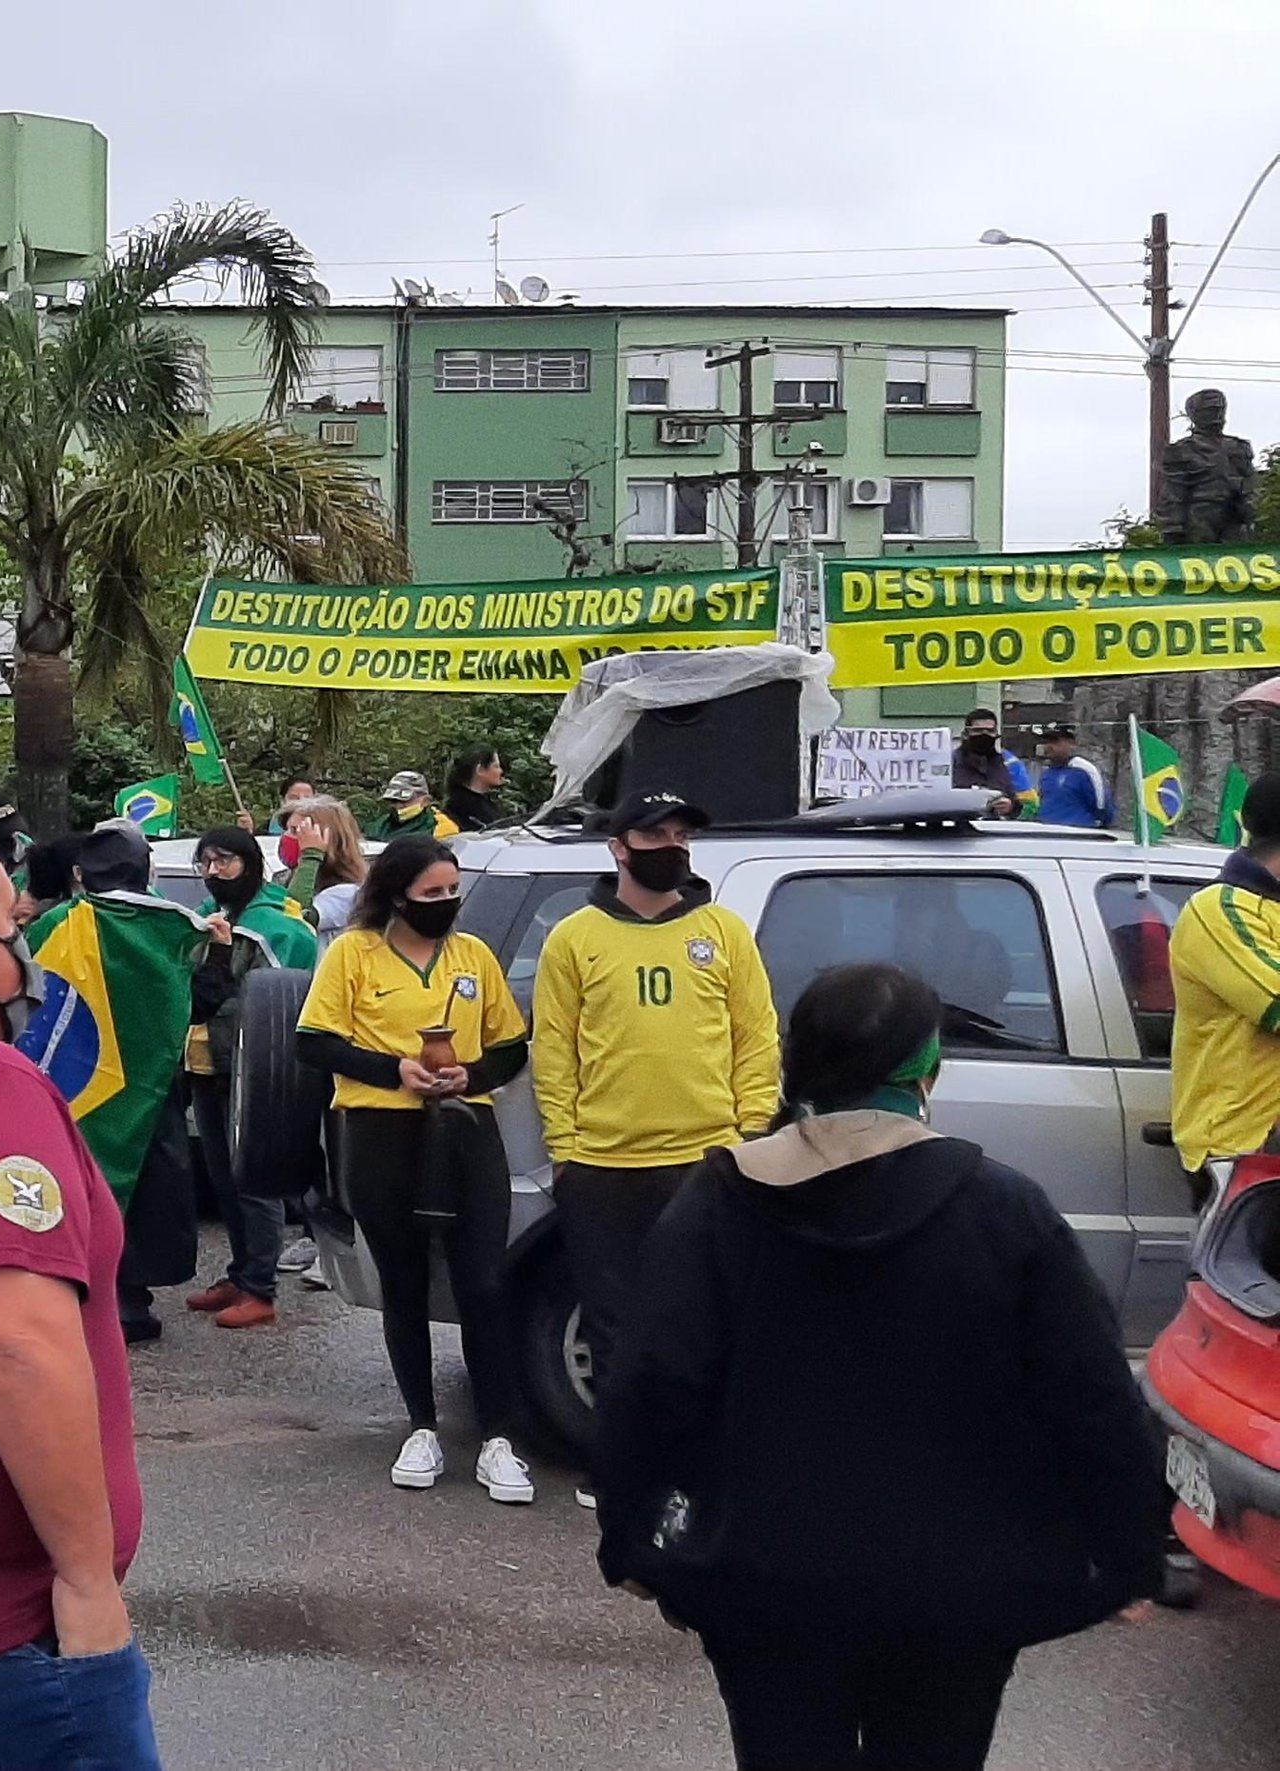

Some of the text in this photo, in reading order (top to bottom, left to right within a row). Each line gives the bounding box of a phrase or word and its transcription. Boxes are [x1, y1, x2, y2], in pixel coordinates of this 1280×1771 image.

[842, 552, 1280, 612] DESTITUIÇÃO DOS
[210, 580, 770, 636] DESTITUIÇÃO DOS MINISTROS DO STF
[228, 641, 311, 675] TODO
[318, 647, 341, 677] O
[346, 649, 452, 681] PODER
[458, 648, 572, 681] EMANA
[883, 616, 1266, 671] TODO O PODER
[869, 730, 944, 751] RESPECT
[877, 759, 928, 782] VOTE
[635, 965, 672, 1008] 10
